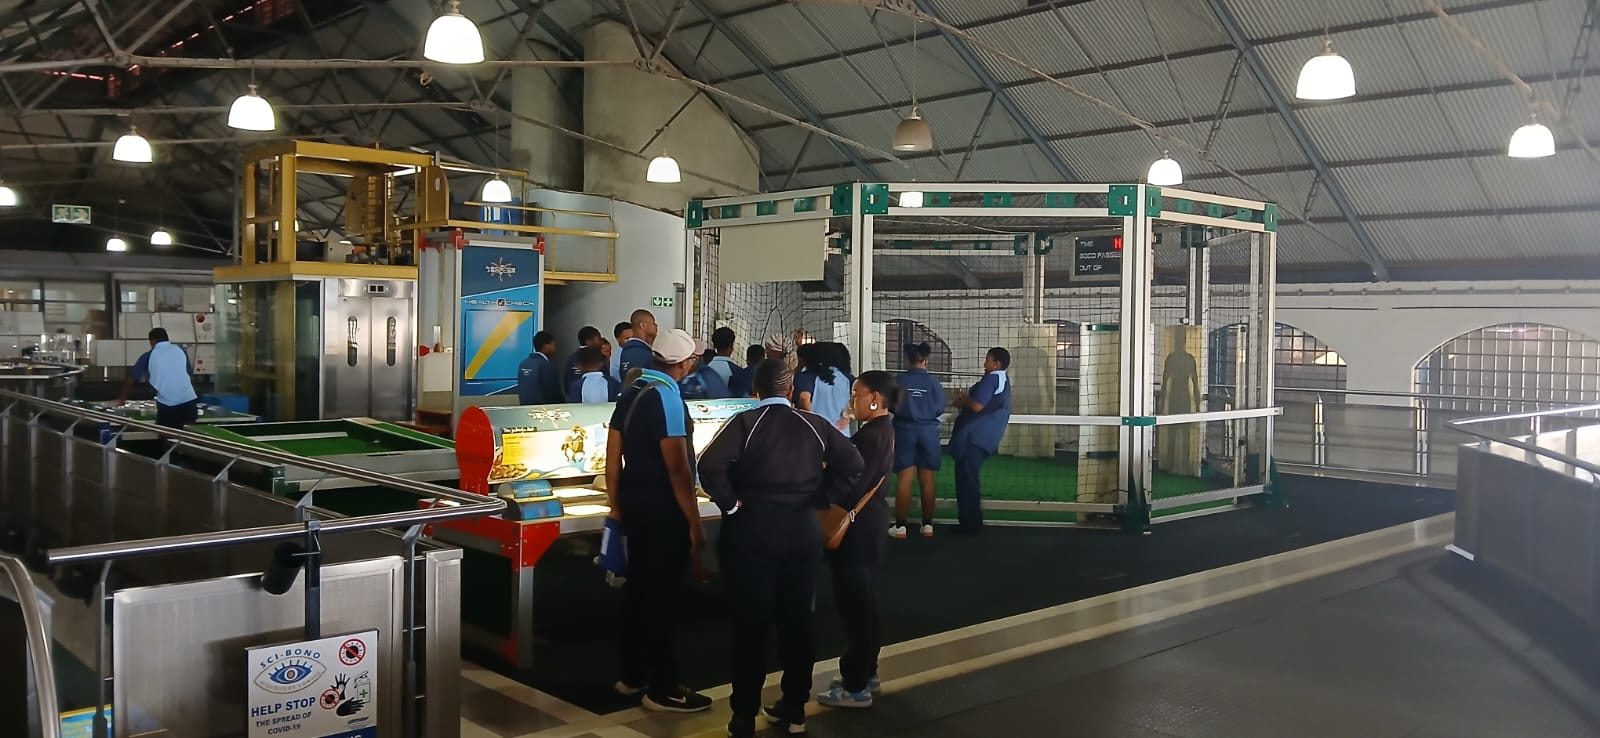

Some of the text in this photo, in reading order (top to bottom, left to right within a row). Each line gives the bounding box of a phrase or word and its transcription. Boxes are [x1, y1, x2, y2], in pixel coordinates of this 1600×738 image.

[260, 648, 321, 669] SCI-BONO
[251, 696, 316, 718] HELP STOP
[256, 719, 270, 728] THE
[272, 712, 301, 725] SPREAD
[268, 724, 302, 734] COVID-19
